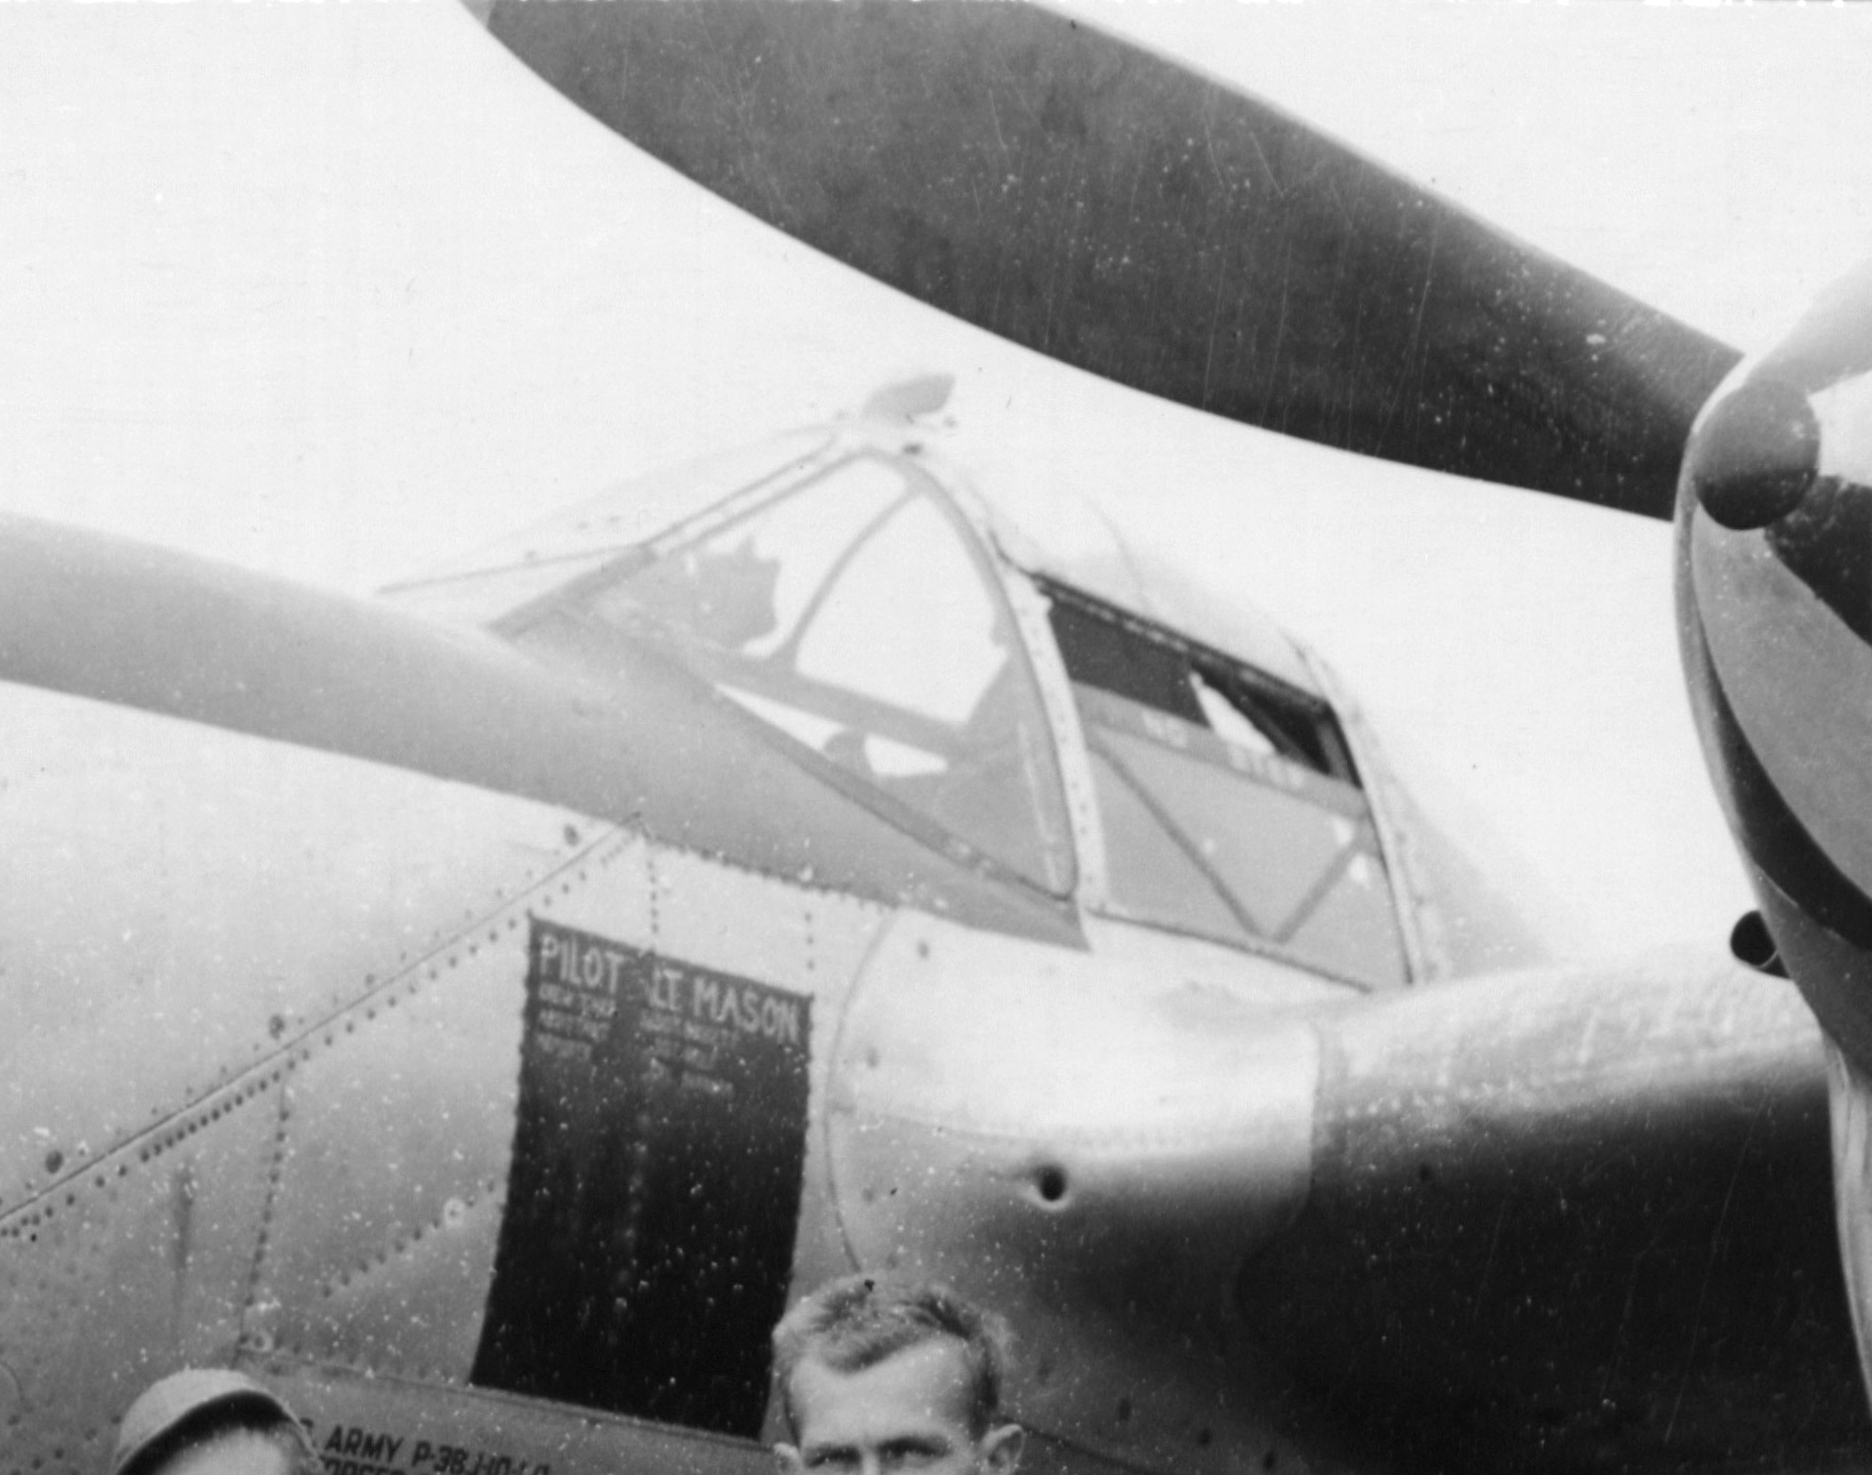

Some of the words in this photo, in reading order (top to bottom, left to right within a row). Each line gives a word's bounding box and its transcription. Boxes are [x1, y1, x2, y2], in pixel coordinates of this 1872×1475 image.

[539, 932, 625, 994] PILOT
[692, 976, 801, 1045] MASON
[324, 1424, 405, 1463] ARMY
